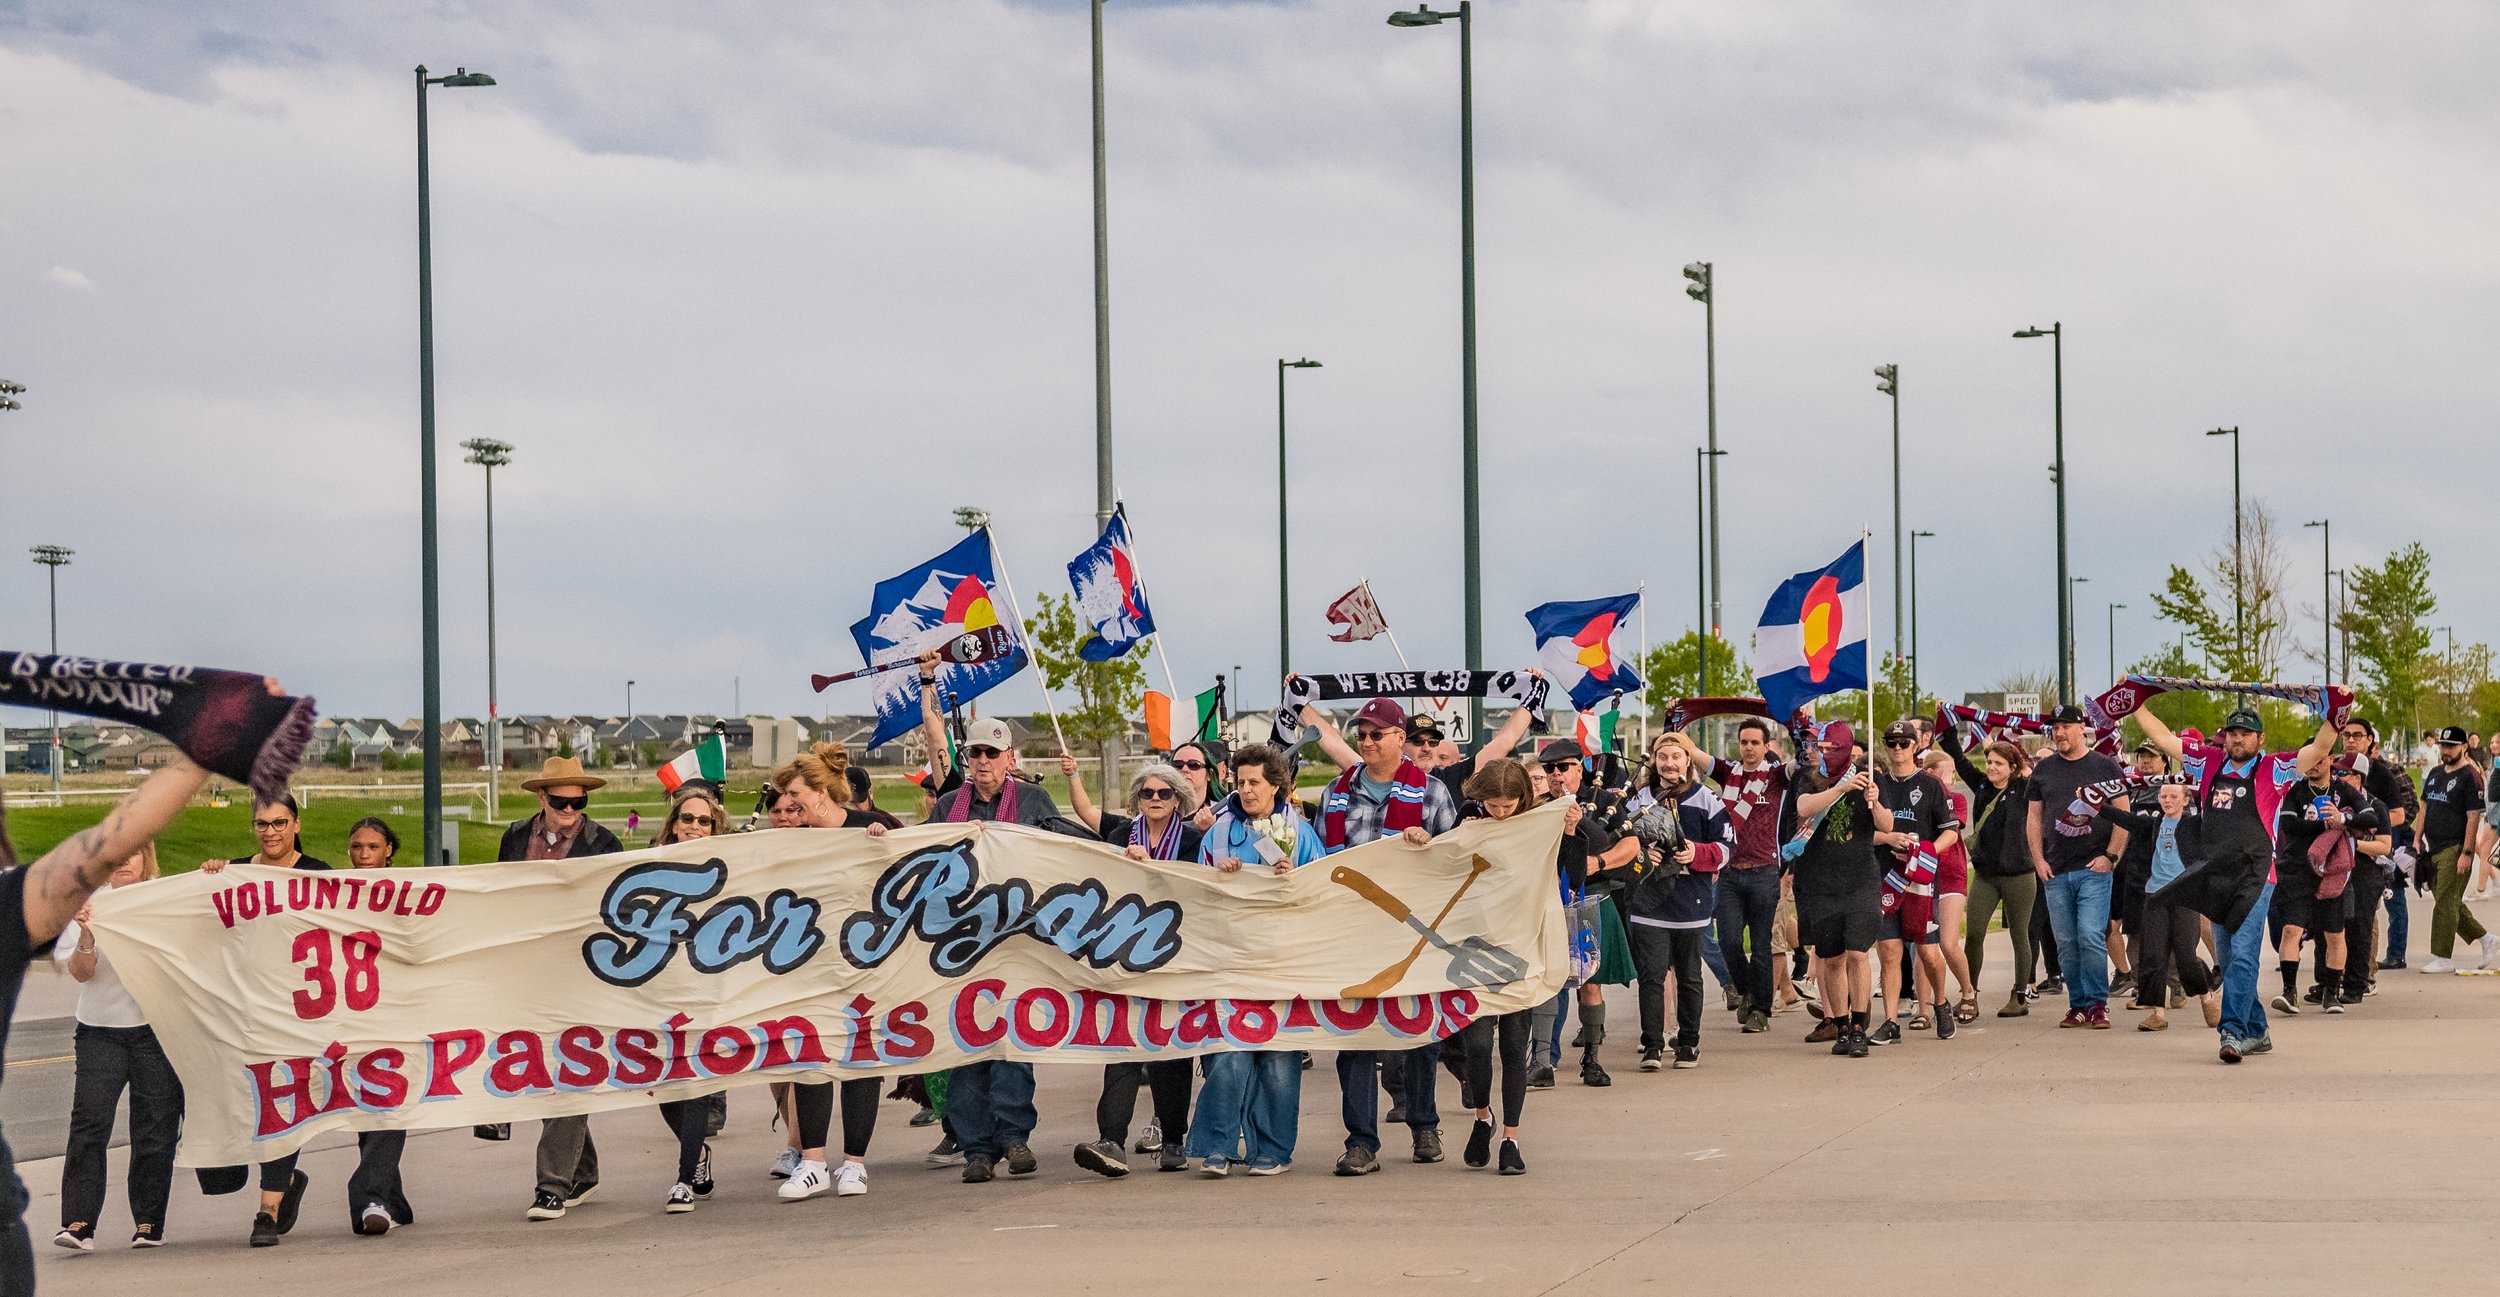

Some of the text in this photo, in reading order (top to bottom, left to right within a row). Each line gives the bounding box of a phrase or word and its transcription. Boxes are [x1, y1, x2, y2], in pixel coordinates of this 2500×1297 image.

[1334, 670, 1471, 693] WE ARE C38
[2008, 697, 2038, 705] SPEED
[212, 877, 447, 929] VOLUNTOLD
[582, 838, 1183, 988] For Ryan
[291, 928, 382, 1020] 38
[244, 1039, 409, 1142] His
[419, 1010, 831, 1103] Passion
[838, 992, 936, 1067] is
